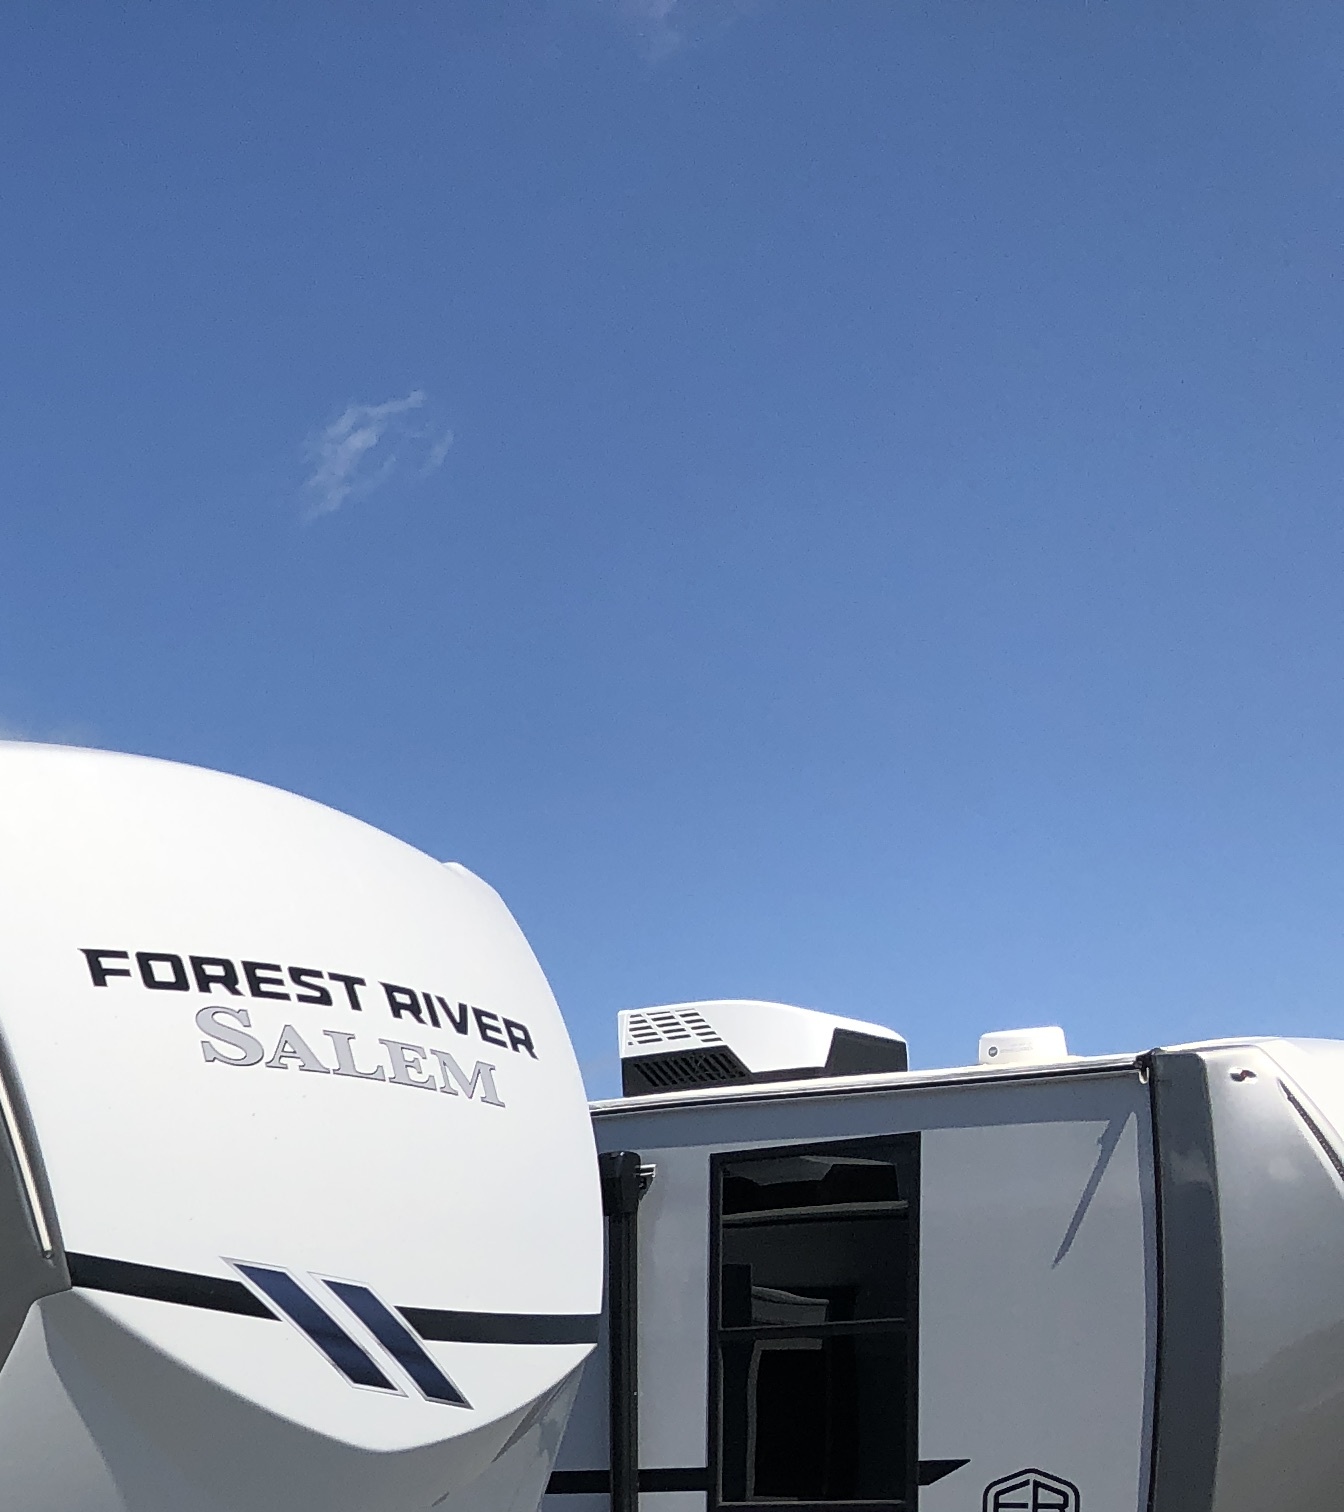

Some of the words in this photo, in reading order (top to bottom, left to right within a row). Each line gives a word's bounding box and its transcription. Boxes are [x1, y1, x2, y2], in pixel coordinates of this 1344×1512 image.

[76, 946, 367, 1012] FOREST
[377, 980, 540, 1060] RIVER
[195, 1005, 506, 1108] SALEM
